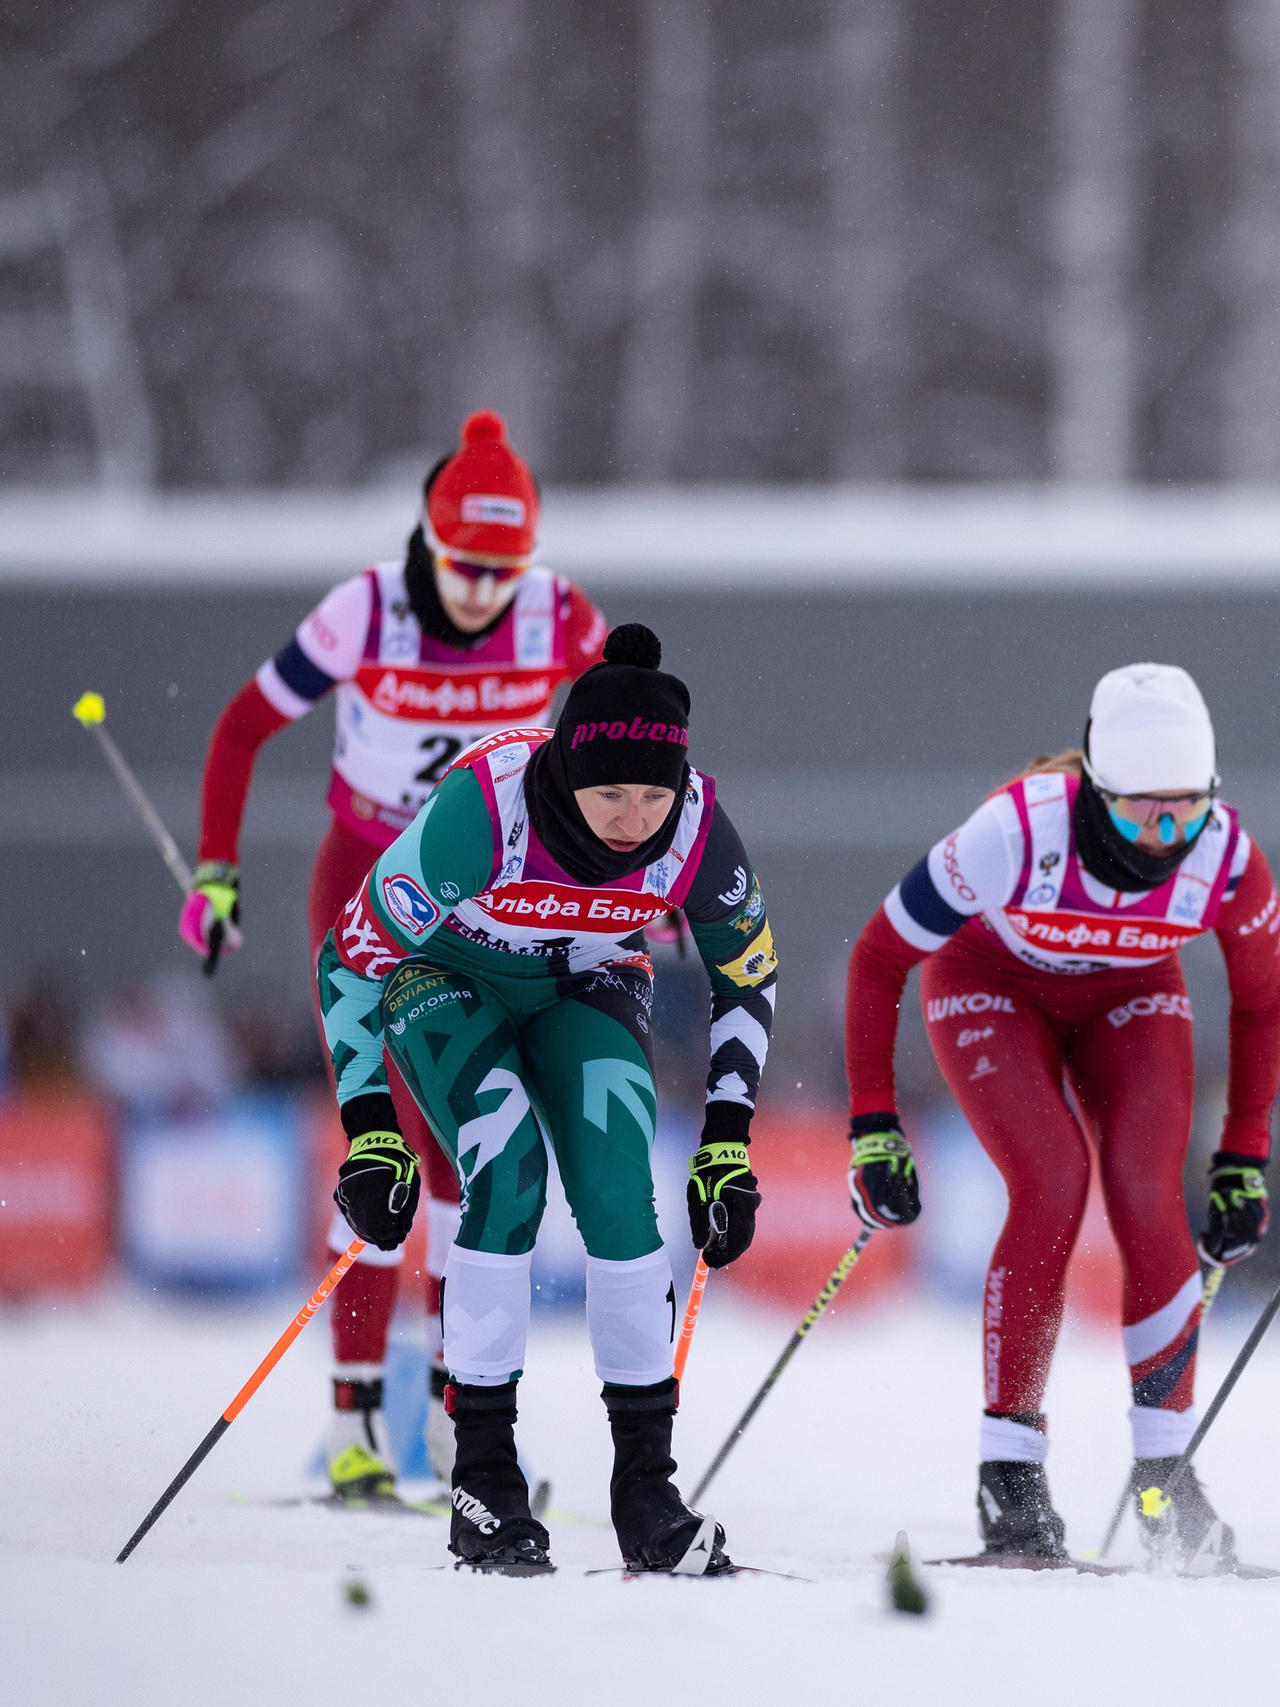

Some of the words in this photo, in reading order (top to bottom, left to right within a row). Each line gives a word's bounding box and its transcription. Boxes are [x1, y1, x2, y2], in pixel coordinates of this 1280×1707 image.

[477, 893, 580, 919] Альфа
[1007, 914, 1112, 948] Альфа
[407, 989, 473, 1019] ЮГОРИЯ
[927, 992, 1016, 1022] LUKOIL
[451, 1485, 502, 1535] ATOMIC
